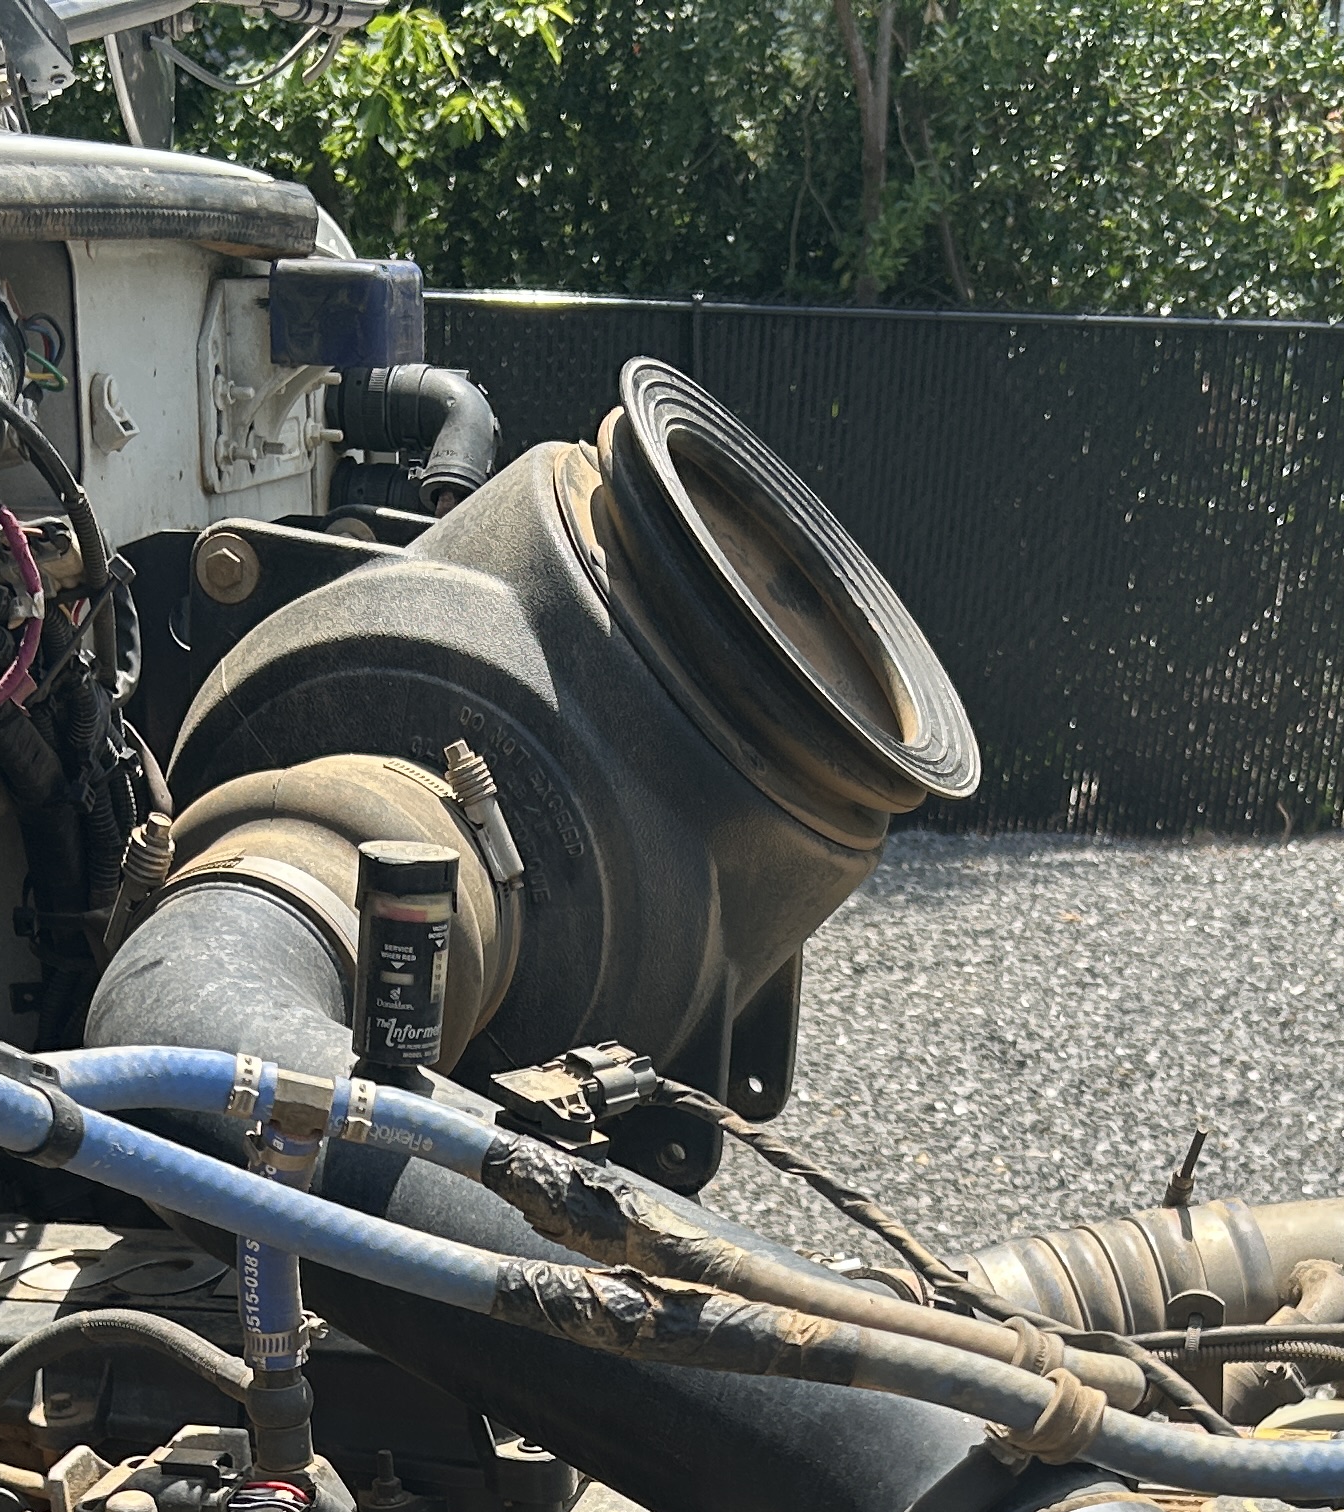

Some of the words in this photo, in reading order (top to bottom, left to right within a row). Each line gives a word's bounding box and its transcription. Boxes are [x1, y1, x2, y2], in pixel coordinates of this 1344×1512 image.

[459, 706, 485, 731] DO
[492, 725, 531, 765] NOT
[529, 764, 584, 857] EXCEED
[376, 1017, 391, 1029] The
